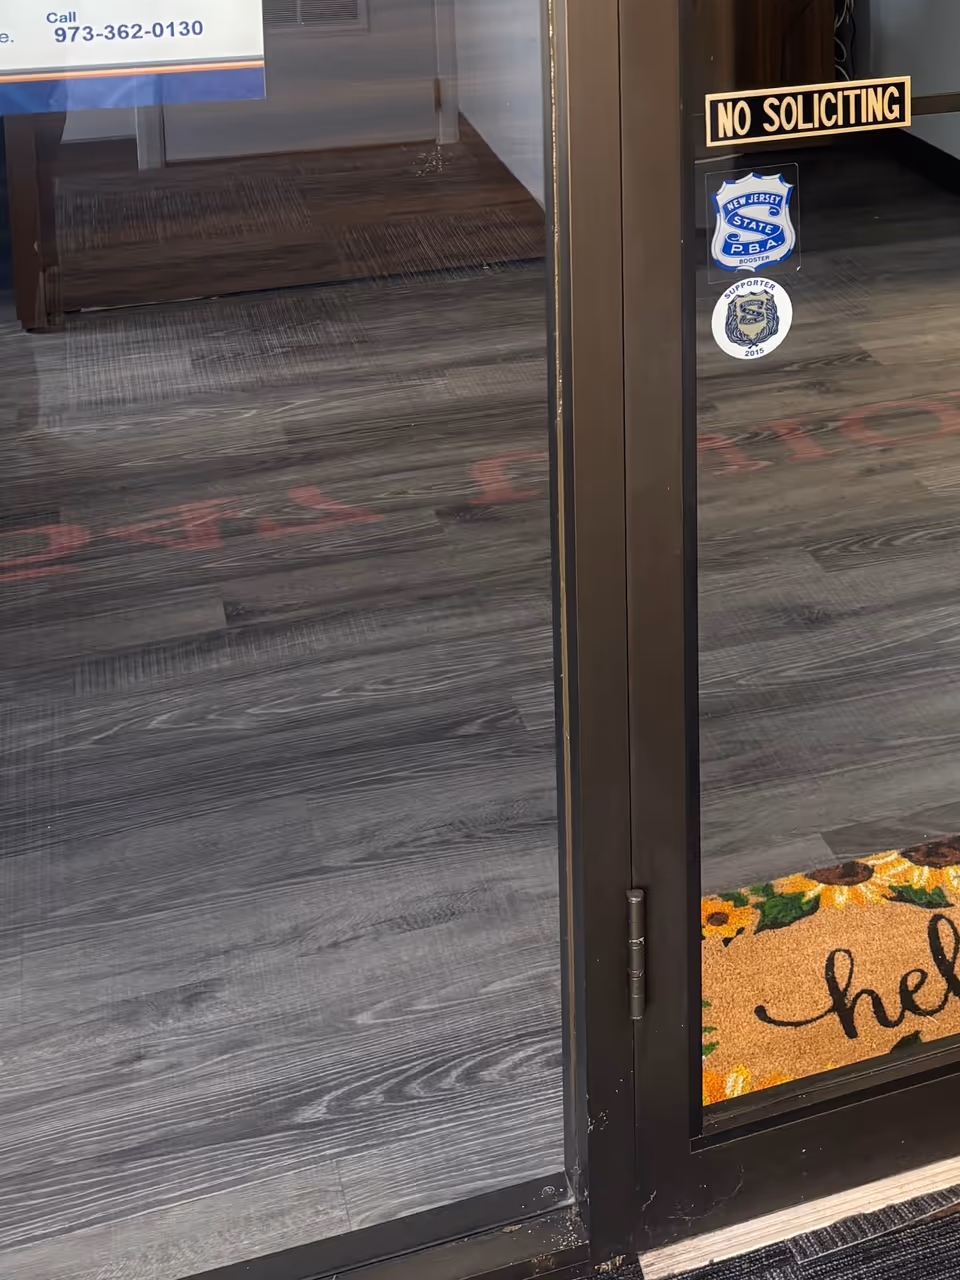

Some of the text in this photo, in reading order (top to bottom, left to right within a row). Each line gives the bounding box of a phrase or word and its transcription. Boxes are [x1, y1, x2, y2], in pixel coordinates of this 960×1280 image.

[46, 11, 77, 24] Call
[54, 20, 204, 43] 973-362-0130
[717, 84, 900, 139] NO SOLICITING
[726, 193, 781, 211] NEW JERSEY
[732, 215, 774, 234] STATE
[730, 236, 782, 255] P.B.A.
[738, 255, 770, 265] BOOSTER
[724, 279, 776, 300] SUPPORTER
[744, 346, 765, 358] 2015
